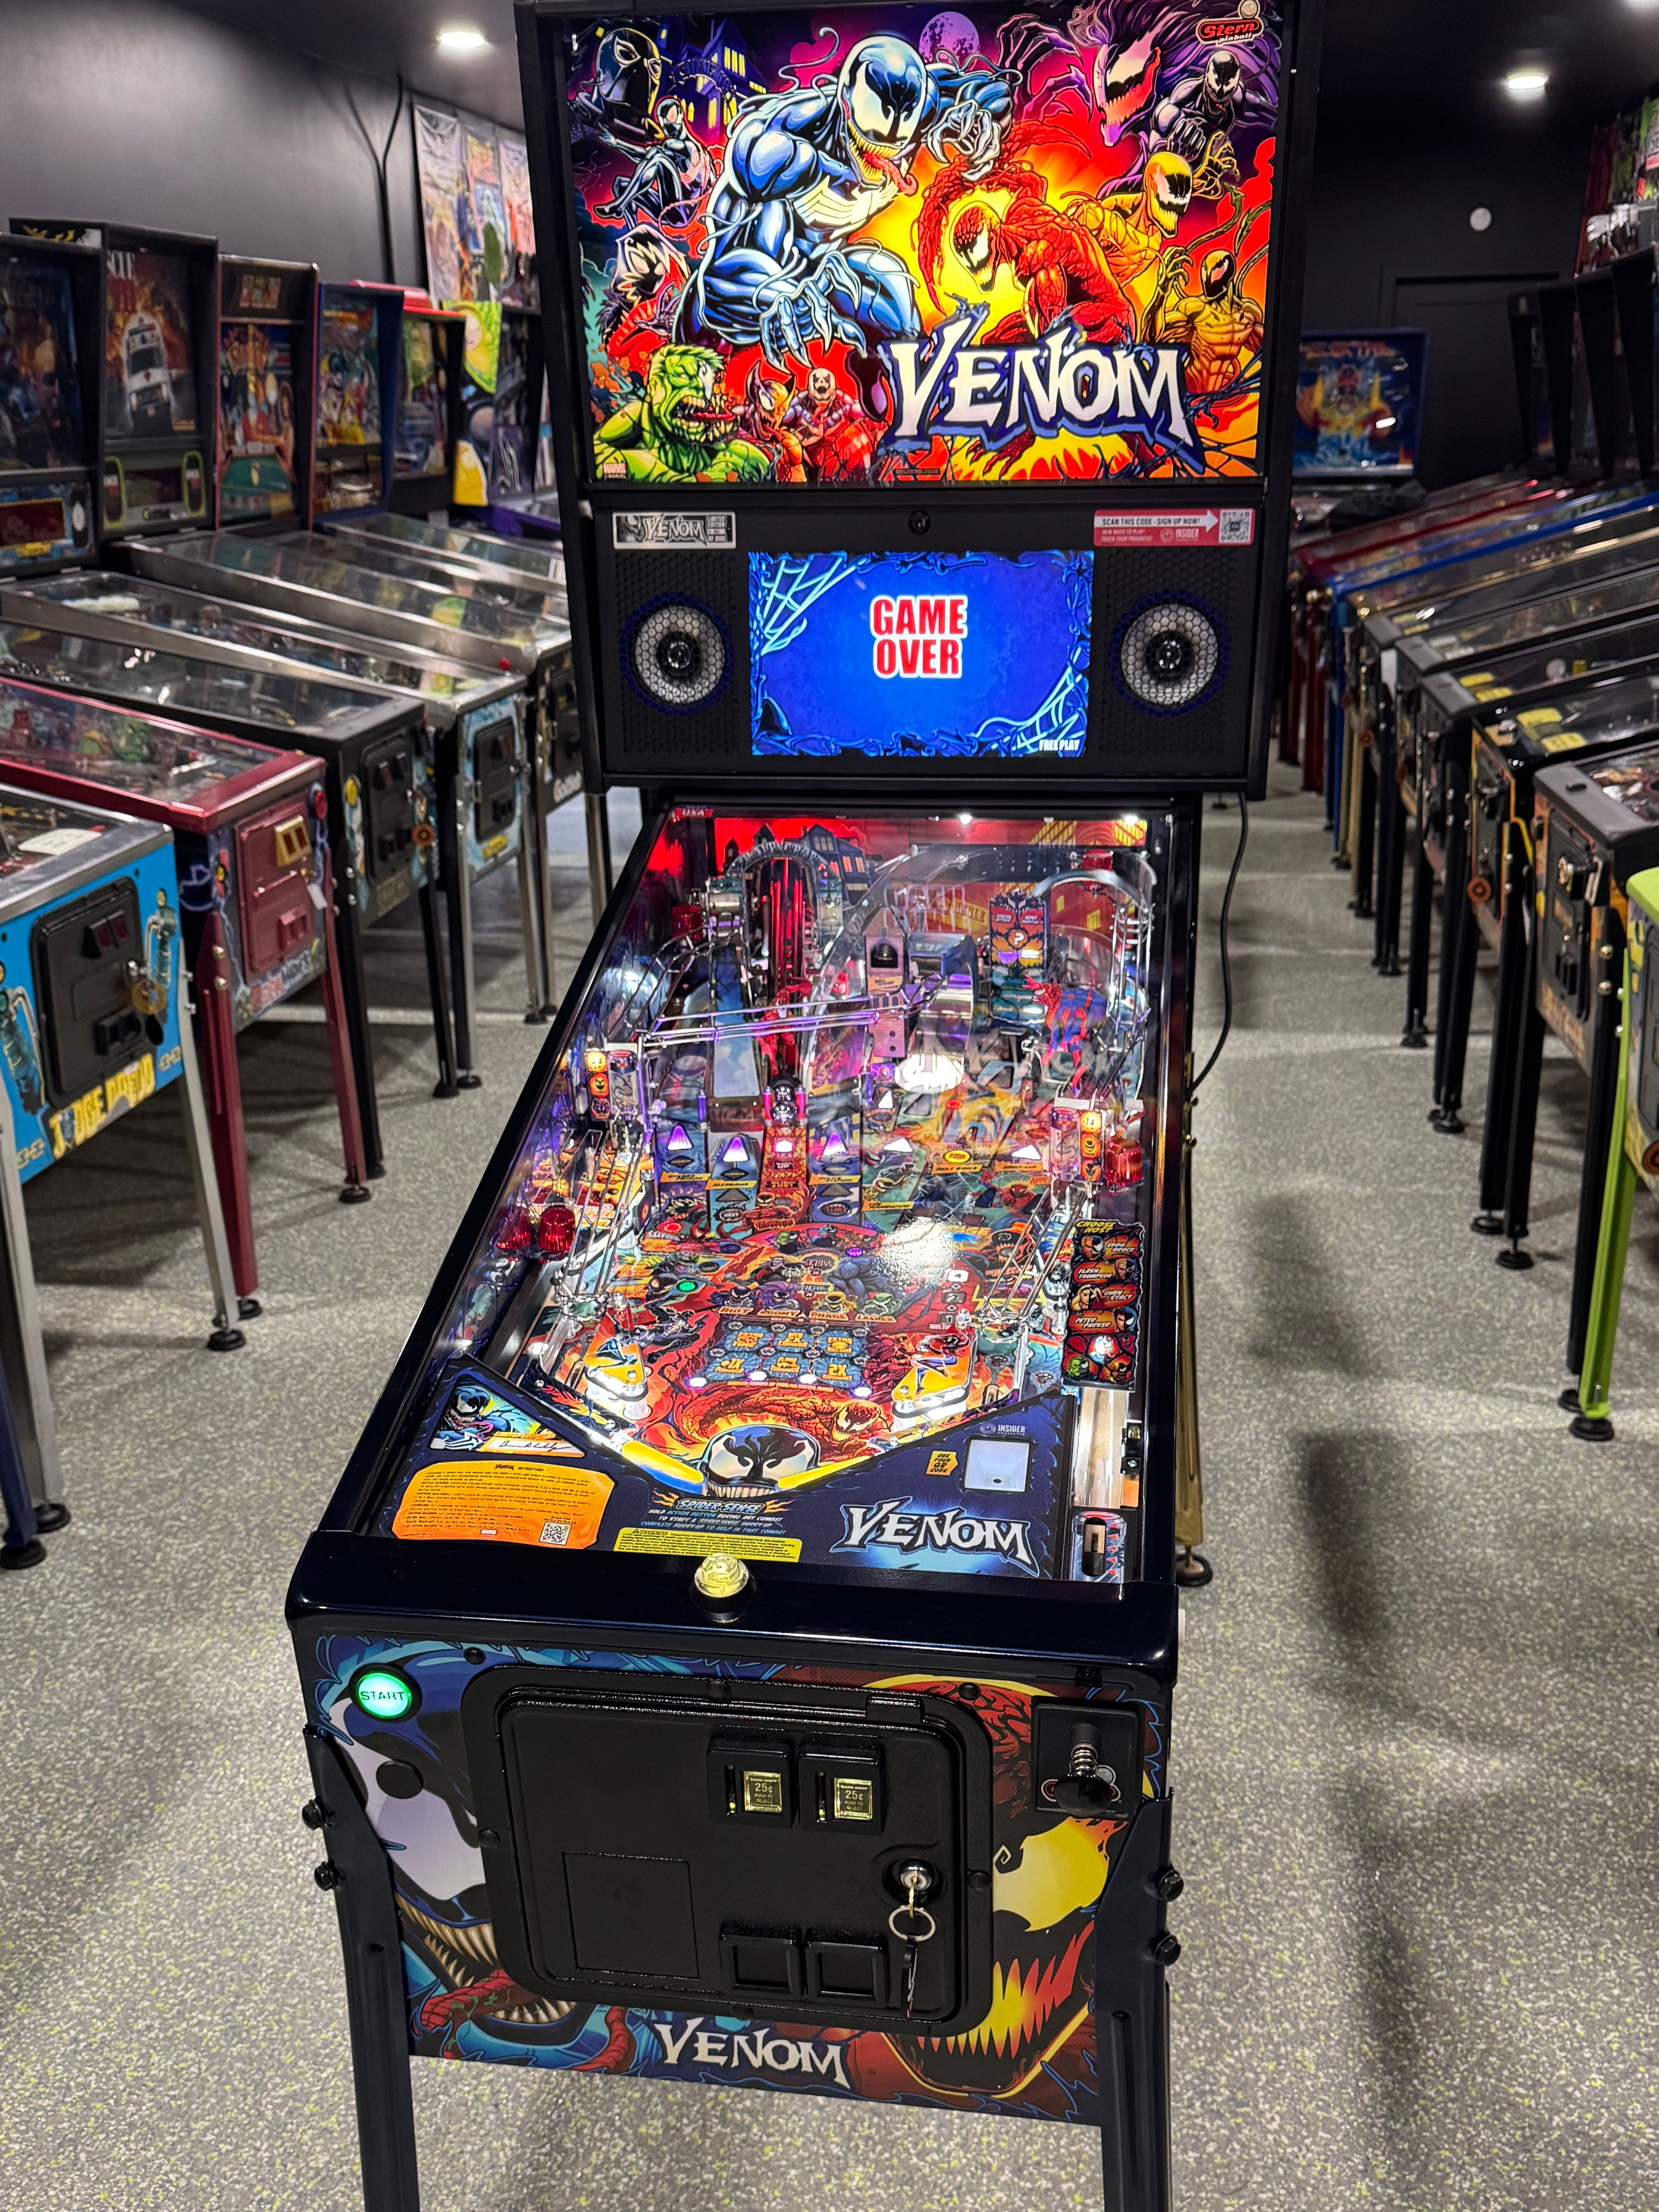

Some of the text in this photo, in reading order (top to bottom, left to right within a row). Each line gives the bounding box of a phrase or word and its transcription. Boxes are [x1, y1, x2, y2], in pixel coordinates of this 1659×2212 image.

[1204, 23, 1254, 38] Stern
[1218, 33, 1252, 44] pinball
[889, 317, 1193, 447] VENOM
[644, 514, 706, 543] VENOM
[1175, 528, 1199, 538] INSIDER
[872, 598, 964, 635] GAME
[876, 639, 960, 675] OVER
[1039, 739, 1080, 751] FREE PLAY
[682, 807, 704, 816] USA
[811, 1312, 847, 1320] PHAGE
[998, 1424, 1025, 1433] INSIDER
[678, 1499, 763, 1513] SPIDER-SENSE
[846, 1497, 1035, 1567] VENOM
[359, 1689, 407, 1702] START
[755, 1782, 774, 1793] 25¢
[845, 1790, 864, 1801] 25¢
[654, 2017, 850, 2087] VENOM
